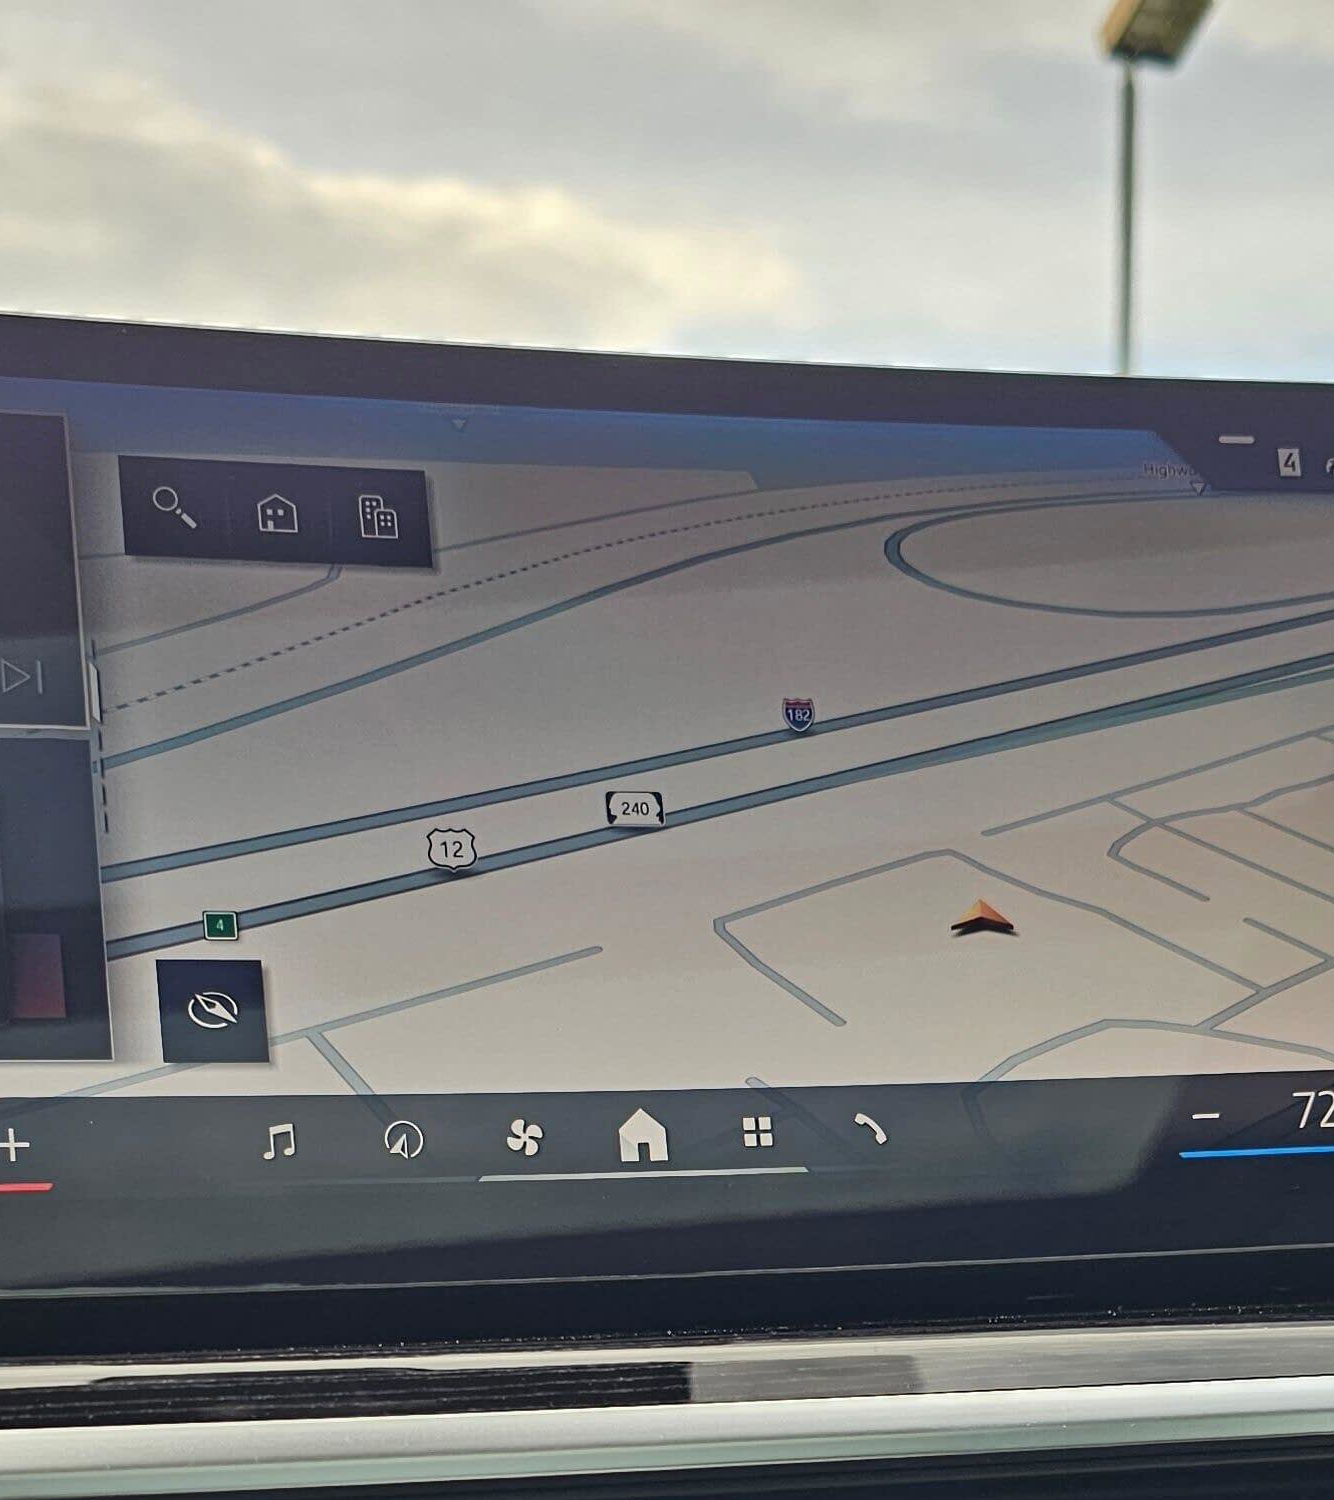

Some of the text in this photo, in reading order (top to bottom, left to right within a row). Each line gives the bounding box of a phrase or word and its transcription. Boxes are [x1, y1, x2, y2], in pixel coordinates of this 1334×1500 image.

[788, 708, 812, 724] 182
[620, 801, 650, 819] 240
[440, 840, 464, 859] 12
